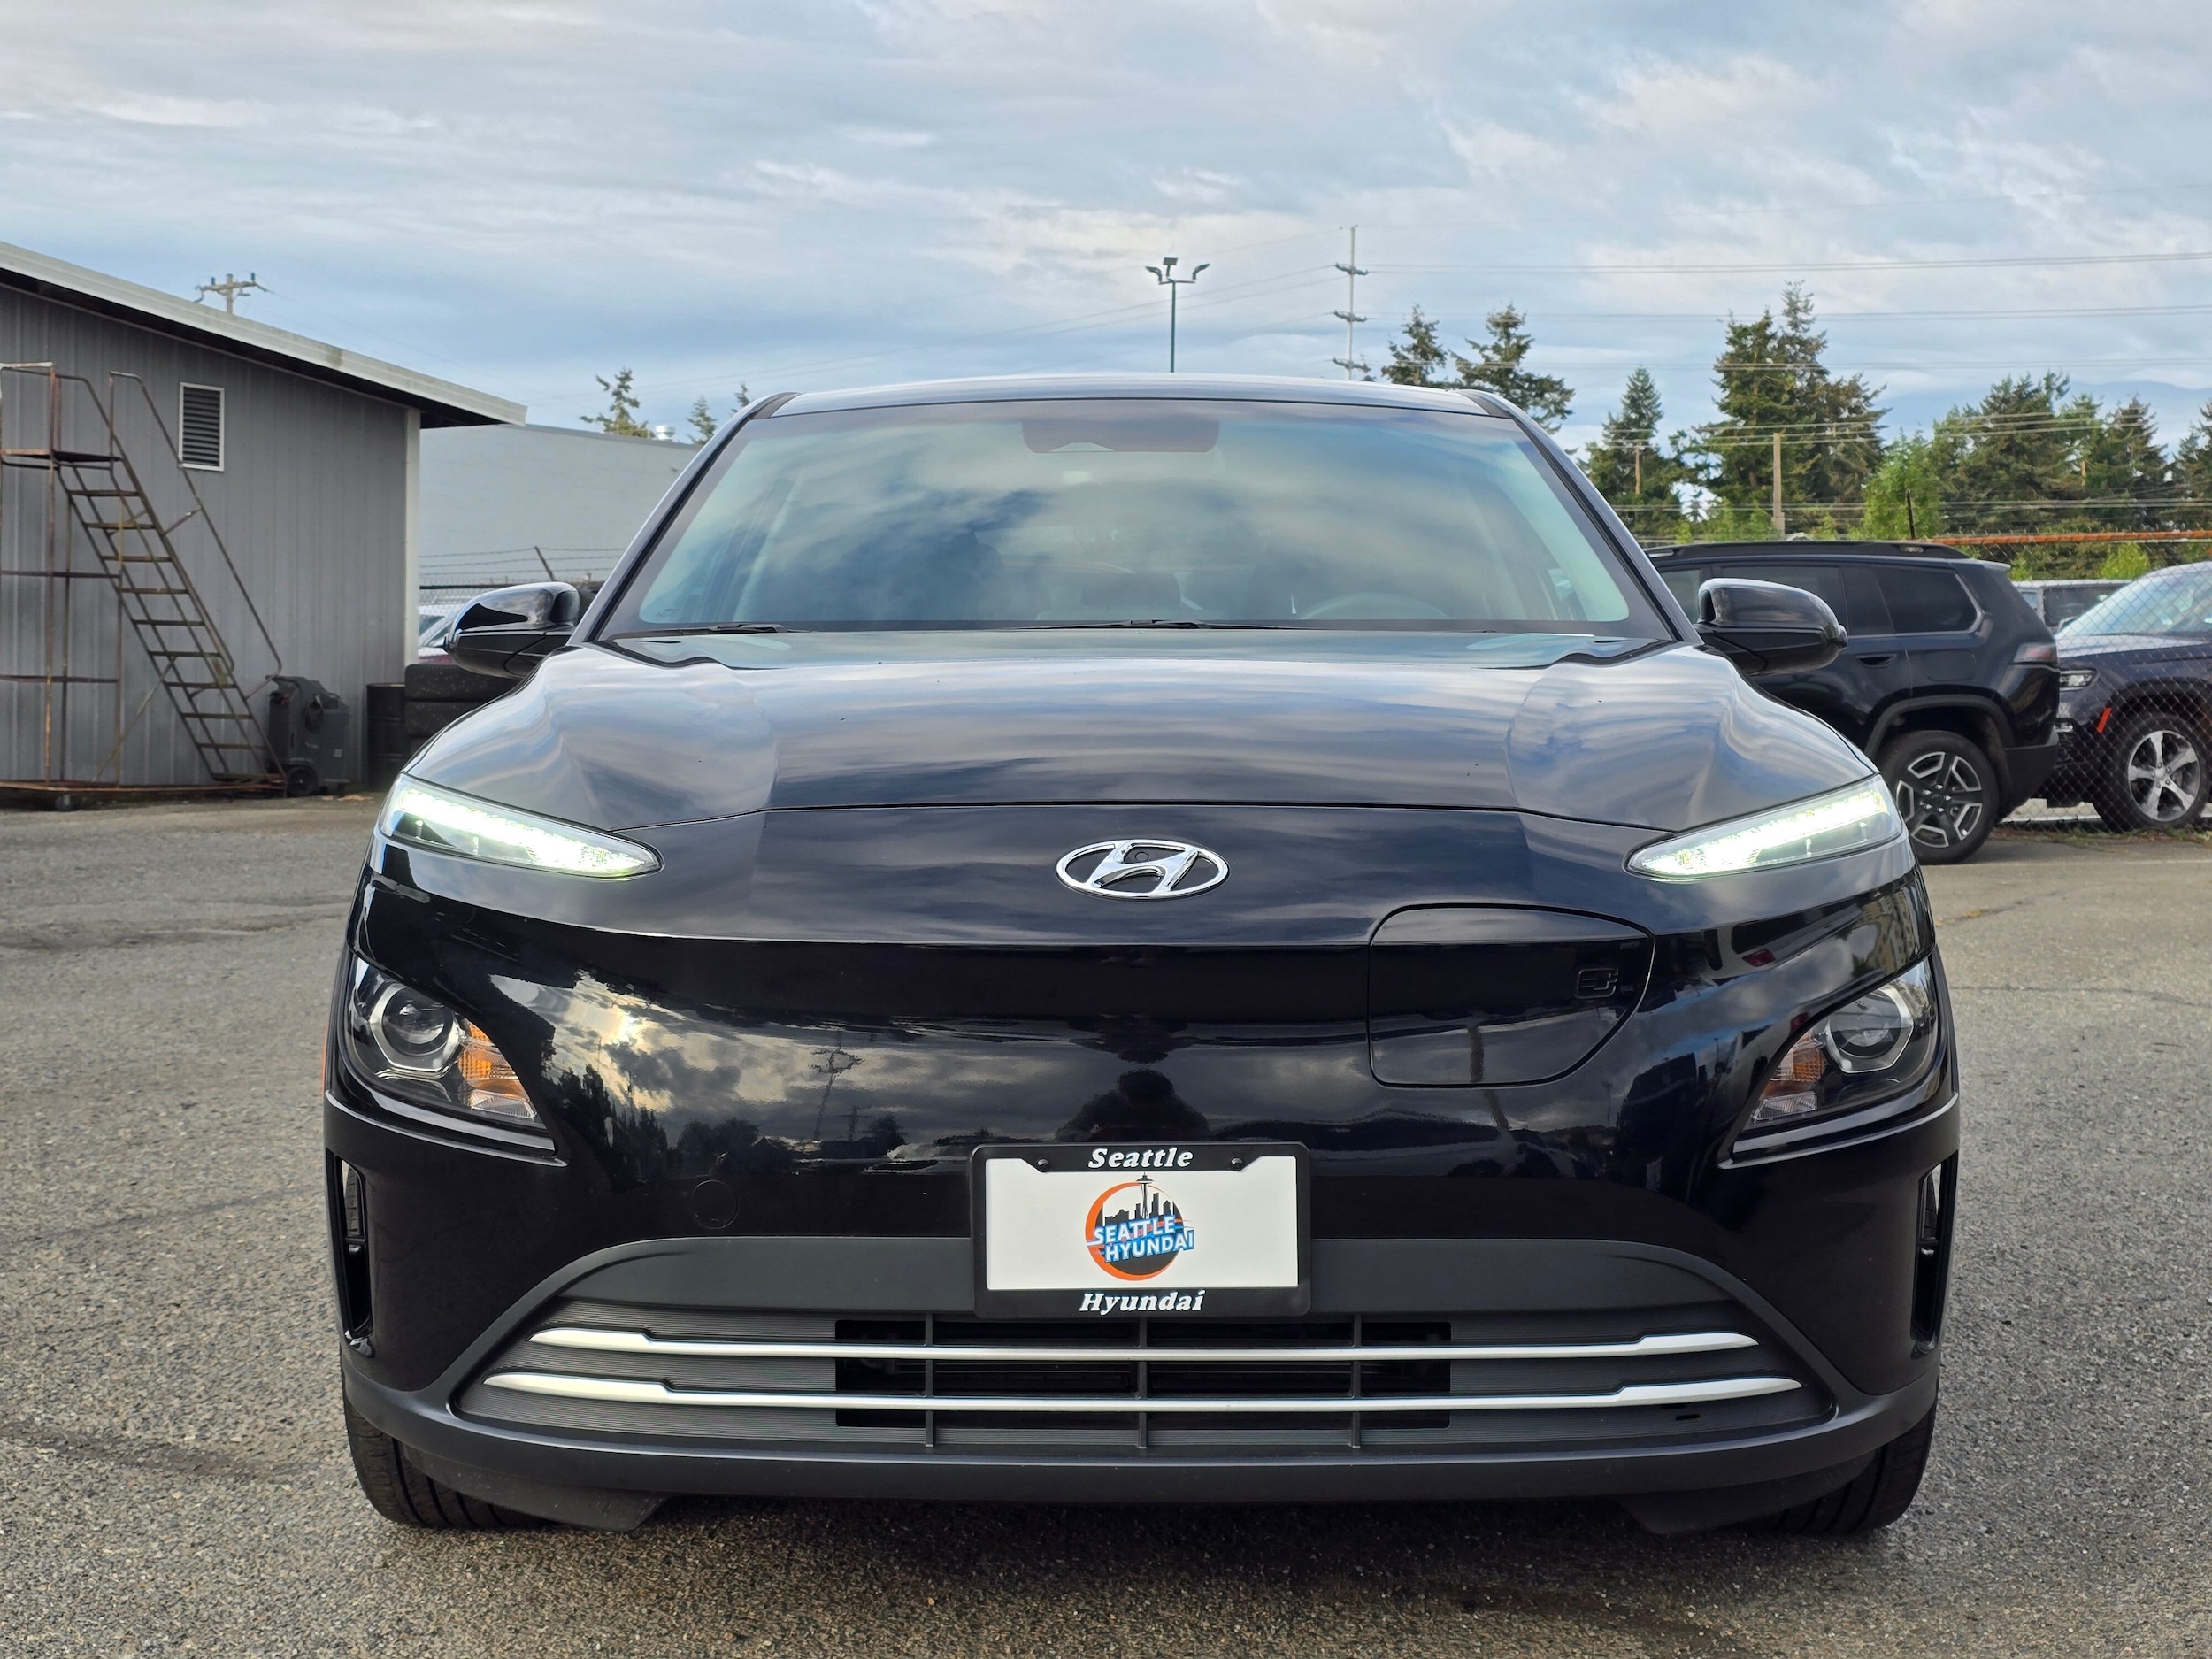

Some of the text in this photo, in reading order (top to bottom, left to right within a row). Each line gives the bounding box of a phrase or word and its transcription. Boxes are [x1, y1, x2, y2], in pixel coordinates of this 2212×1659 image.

[1088, 1148, 1193, 1168] Seattle
[1094, 1216, 1176, 1242] SEATTLE
[1105, 1233, 1194, 1262] HYUNDAI
[1079, 1290, 1206, 1315] Hyundai
